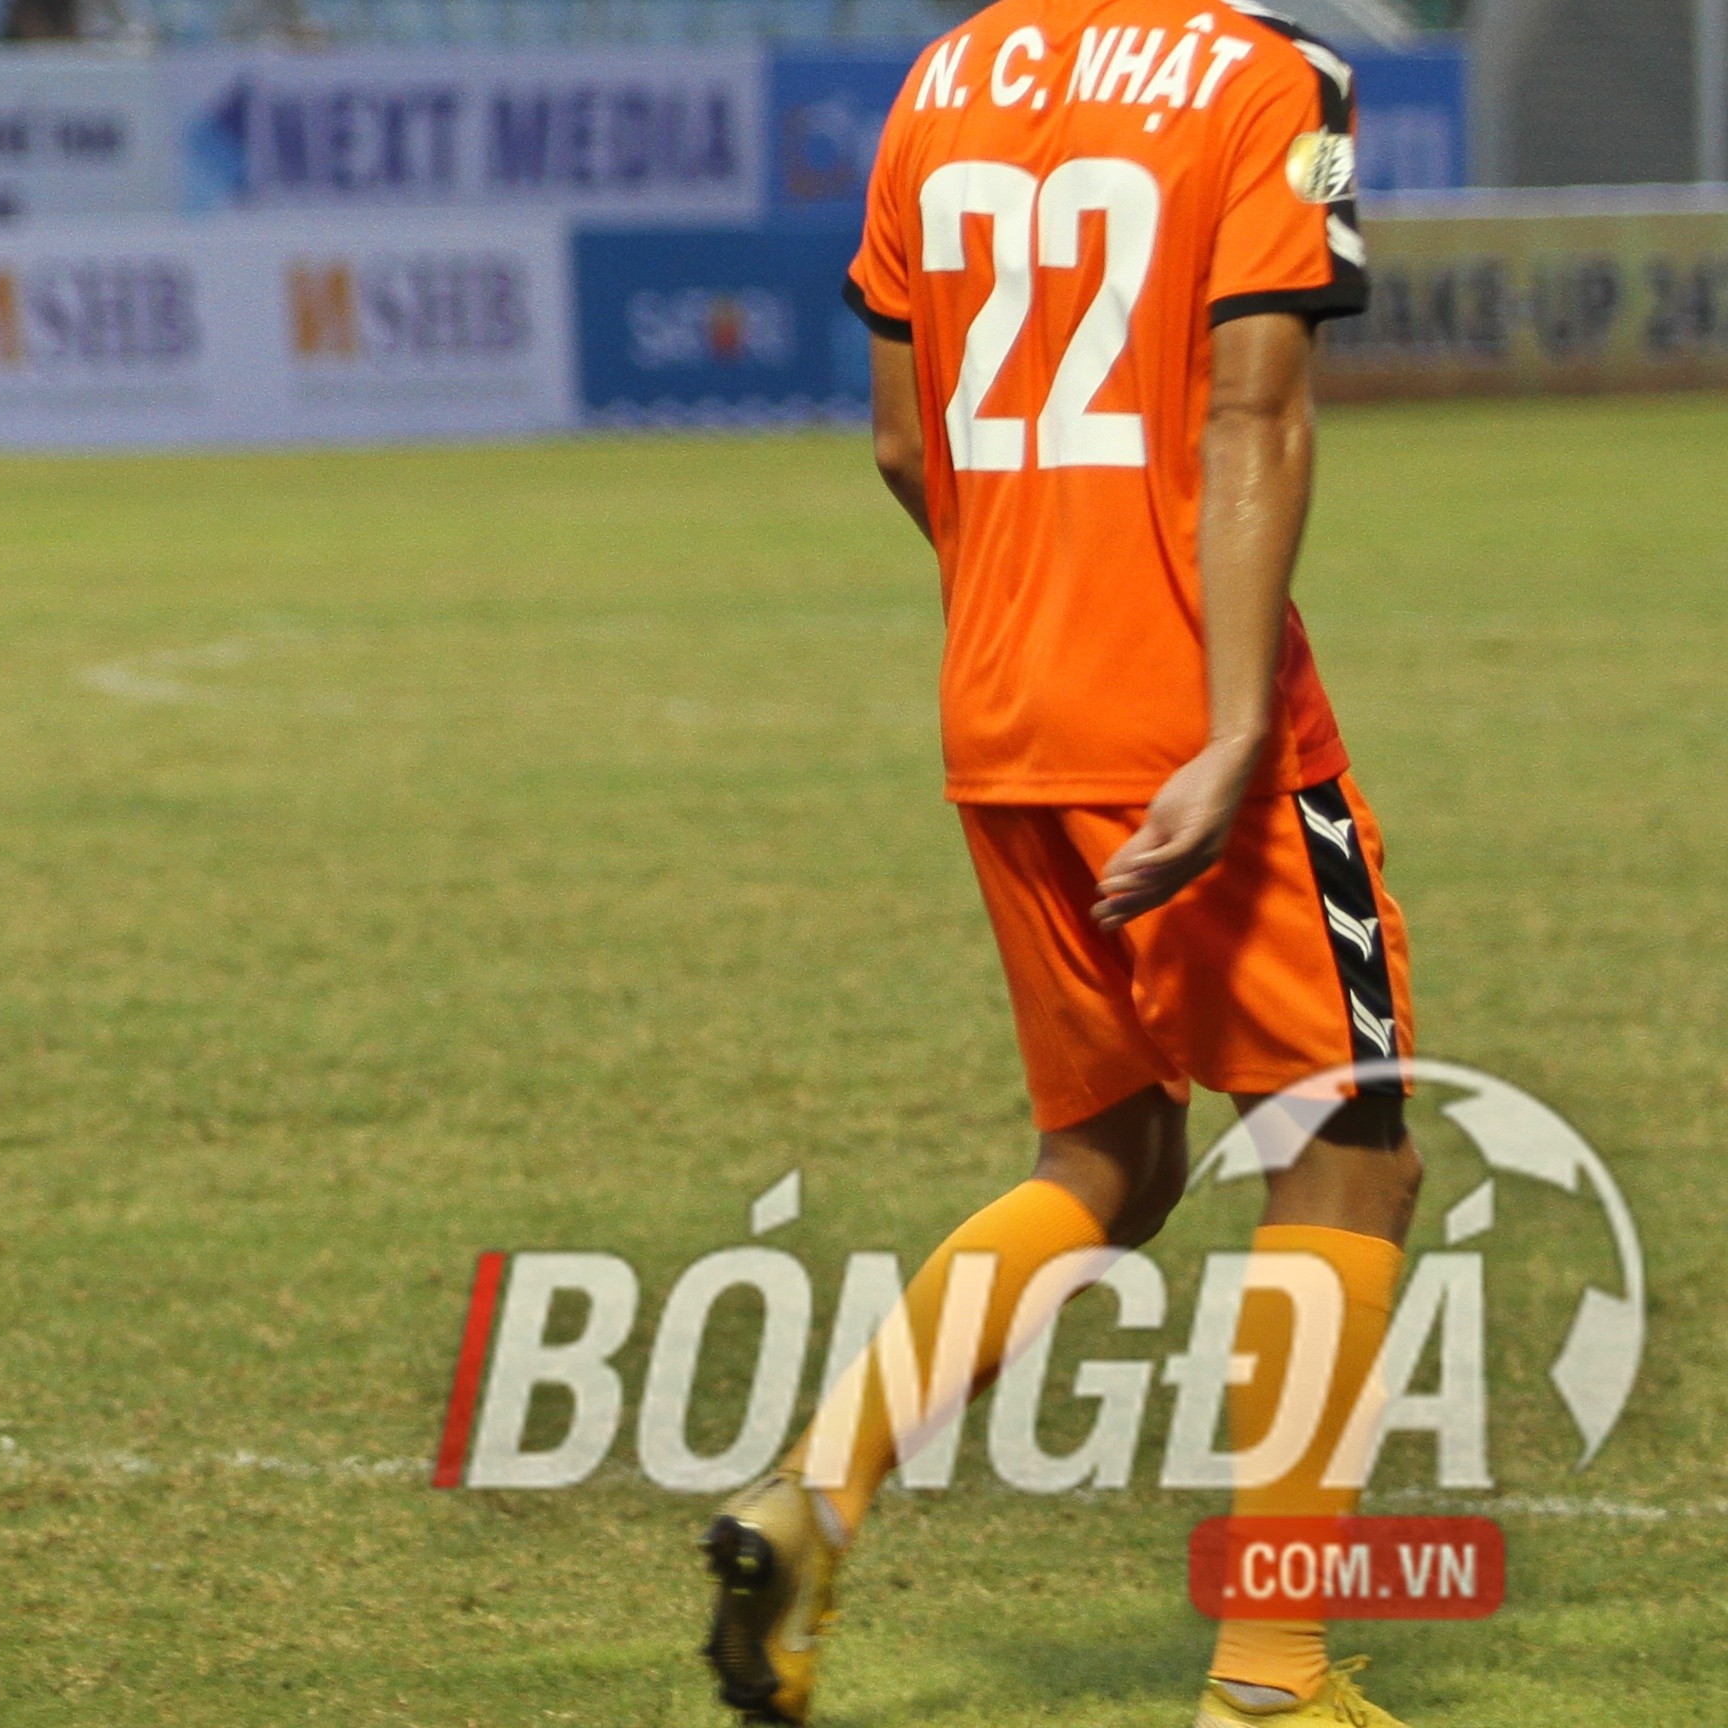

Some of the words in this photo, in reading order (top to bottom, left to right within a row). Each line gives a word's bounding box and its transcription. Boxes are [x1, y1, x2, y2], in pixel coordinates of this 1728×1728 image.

[913, 34, 971, 112] N.
[991, 25, 1048, 110] C.
[1064, 12, 1255, 133] NHẬT
[270, 87, 456, 186] NEXT
[487, 80, 737, 186] MEDIA
[31, 257, 202, 362] SHB
[359, 252, 532, 357] SHB
[919, 157, 1161, 471] 22
